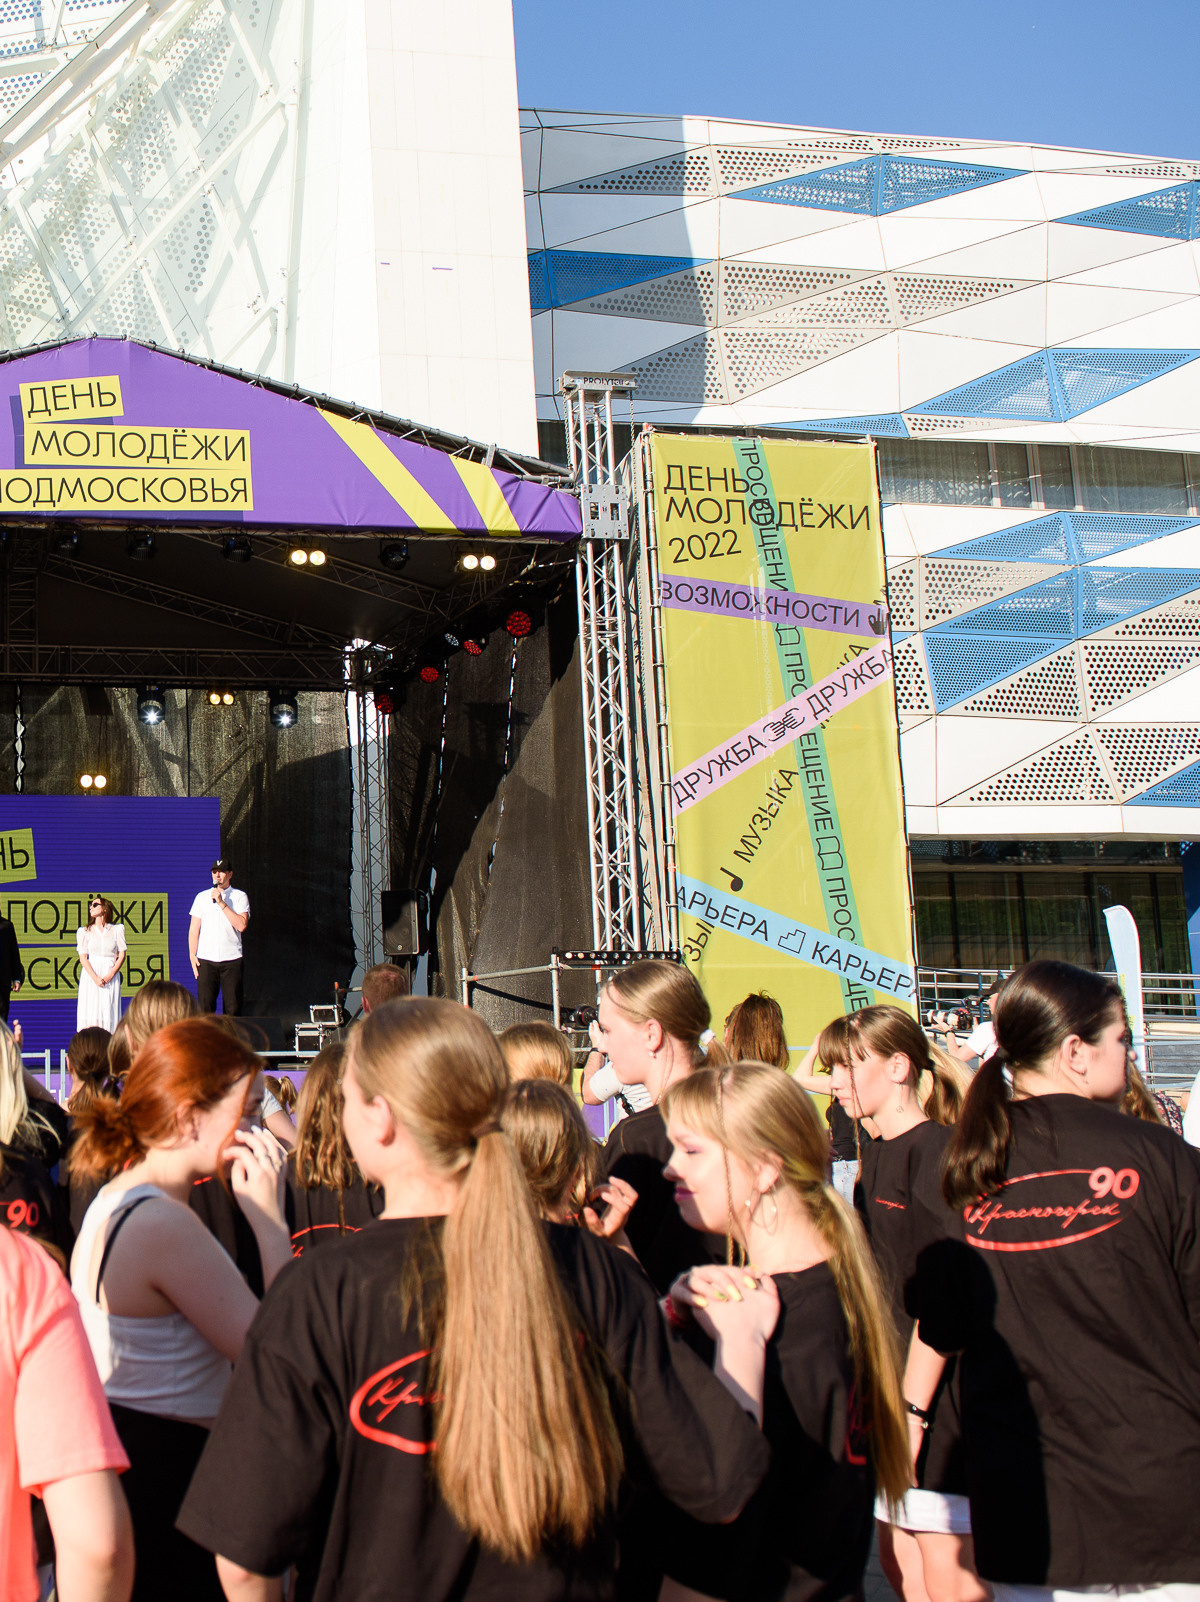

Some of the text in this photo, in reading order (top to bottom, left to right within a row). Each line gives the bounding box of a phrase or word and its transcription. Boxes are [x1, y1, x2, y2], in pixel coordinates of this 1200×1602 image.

[28, 382, 117, 418] ДЕНЬ
[31, 429, 246, 464] МОЛОДЁЖИ
[664, 464, 750, 495] ДЕНЬ
[666, 496, 871, 532] МОЛОДЁЖИ
[668, 529, 742, 564] 2022
[659, 580, 860, 628] ВОЗМОЖНОСТИ
[671, 735, 767, 808] ДРУЖБА
[733, 767, 799, 864] МУЗЫКА
[1088, 1166, 1140, 1199] 90
[7, 1199, 39, 1228] 90
[968, 1199, 1121, 1235] Красногорск
